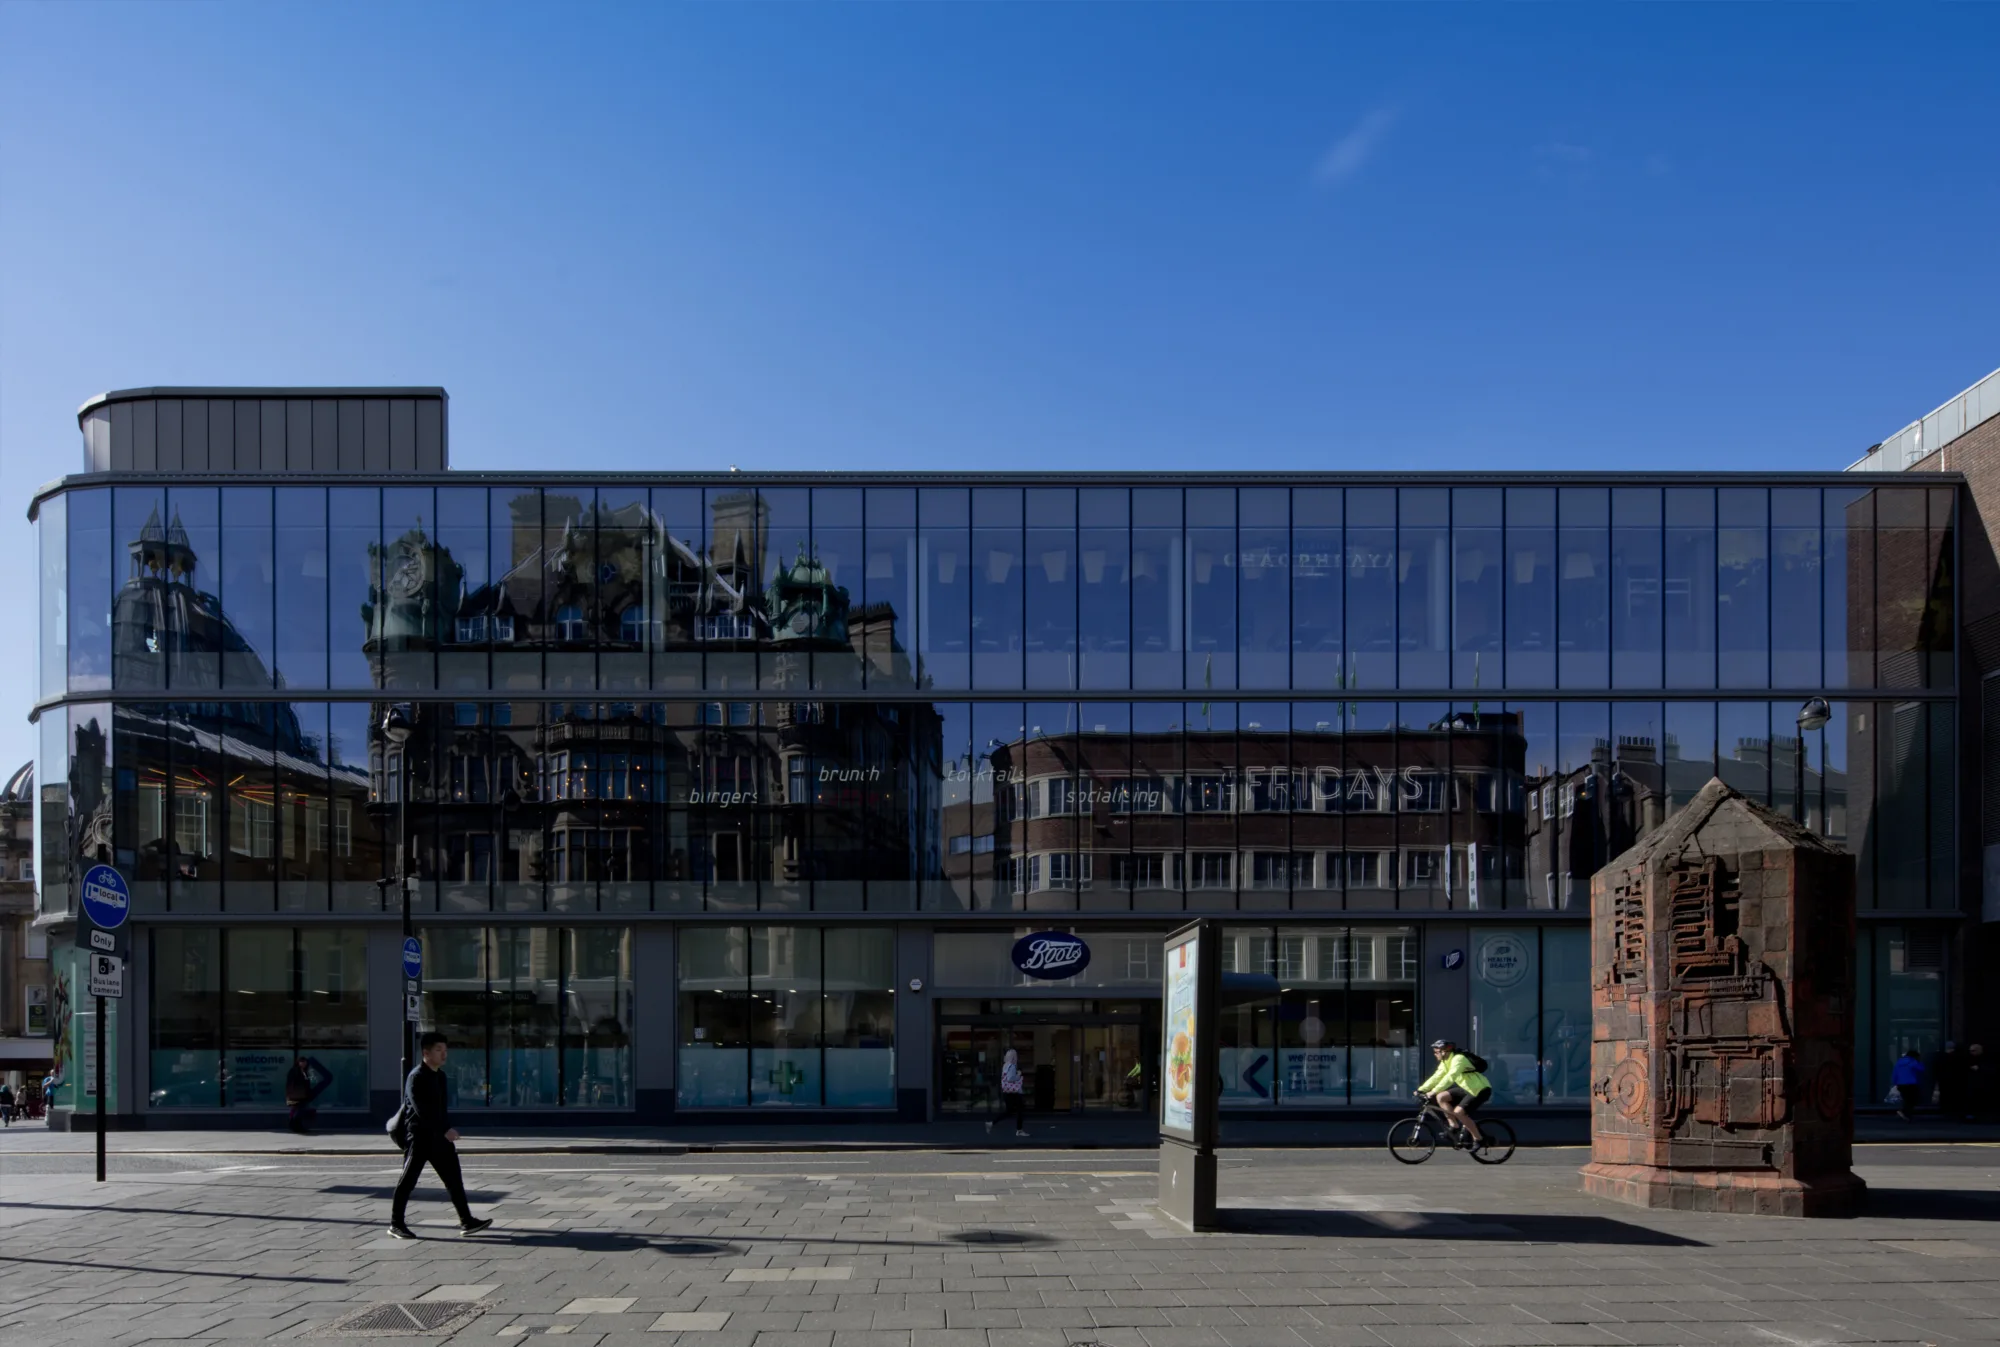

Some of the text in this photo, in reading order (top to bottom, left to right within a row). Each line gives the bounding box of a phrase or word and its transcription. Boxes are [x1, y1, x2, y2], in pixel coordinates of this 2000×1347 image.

[818, 765, 880, 782] brunch
[1245, 766, 1423, 801] FRIDAYS
[689, 787, 758, 808] burgers
[1066, 787, 1159, 807] socialising
[99, 887, 118, 902] local
[93, 934, 112, 948] Only
[1020, 939, 1082, 969] Boots
[93, 977, 120, 987] Bus lane
[93, 987, 120, 995] cameras
[235, 1054, 285, 1064] welcome
